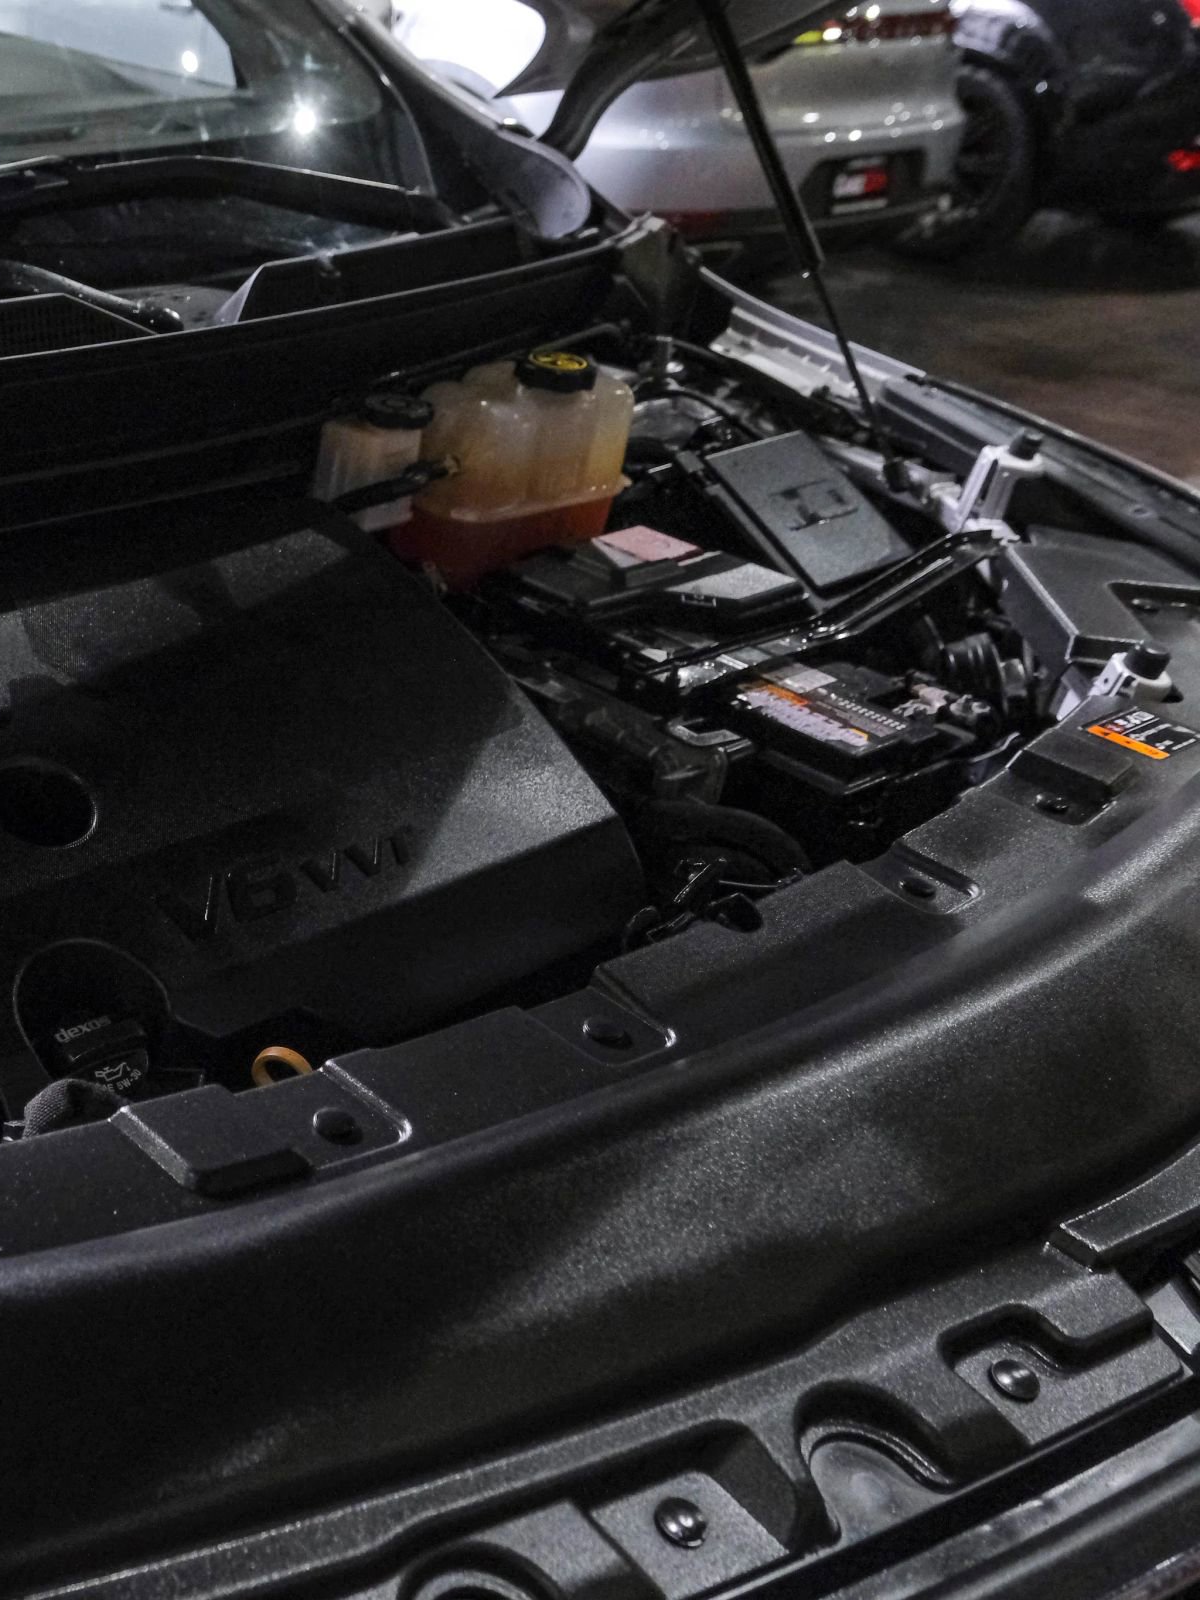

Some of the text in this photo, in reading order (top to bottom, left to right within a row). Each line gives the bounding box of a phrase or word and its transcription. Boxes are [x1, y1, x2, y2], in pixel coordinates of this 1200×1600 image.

[154, 853, 299, 943] V6
[53, 1015, 112, 1044] dexos
[115, 1067, 142, 1091] 5W-30
